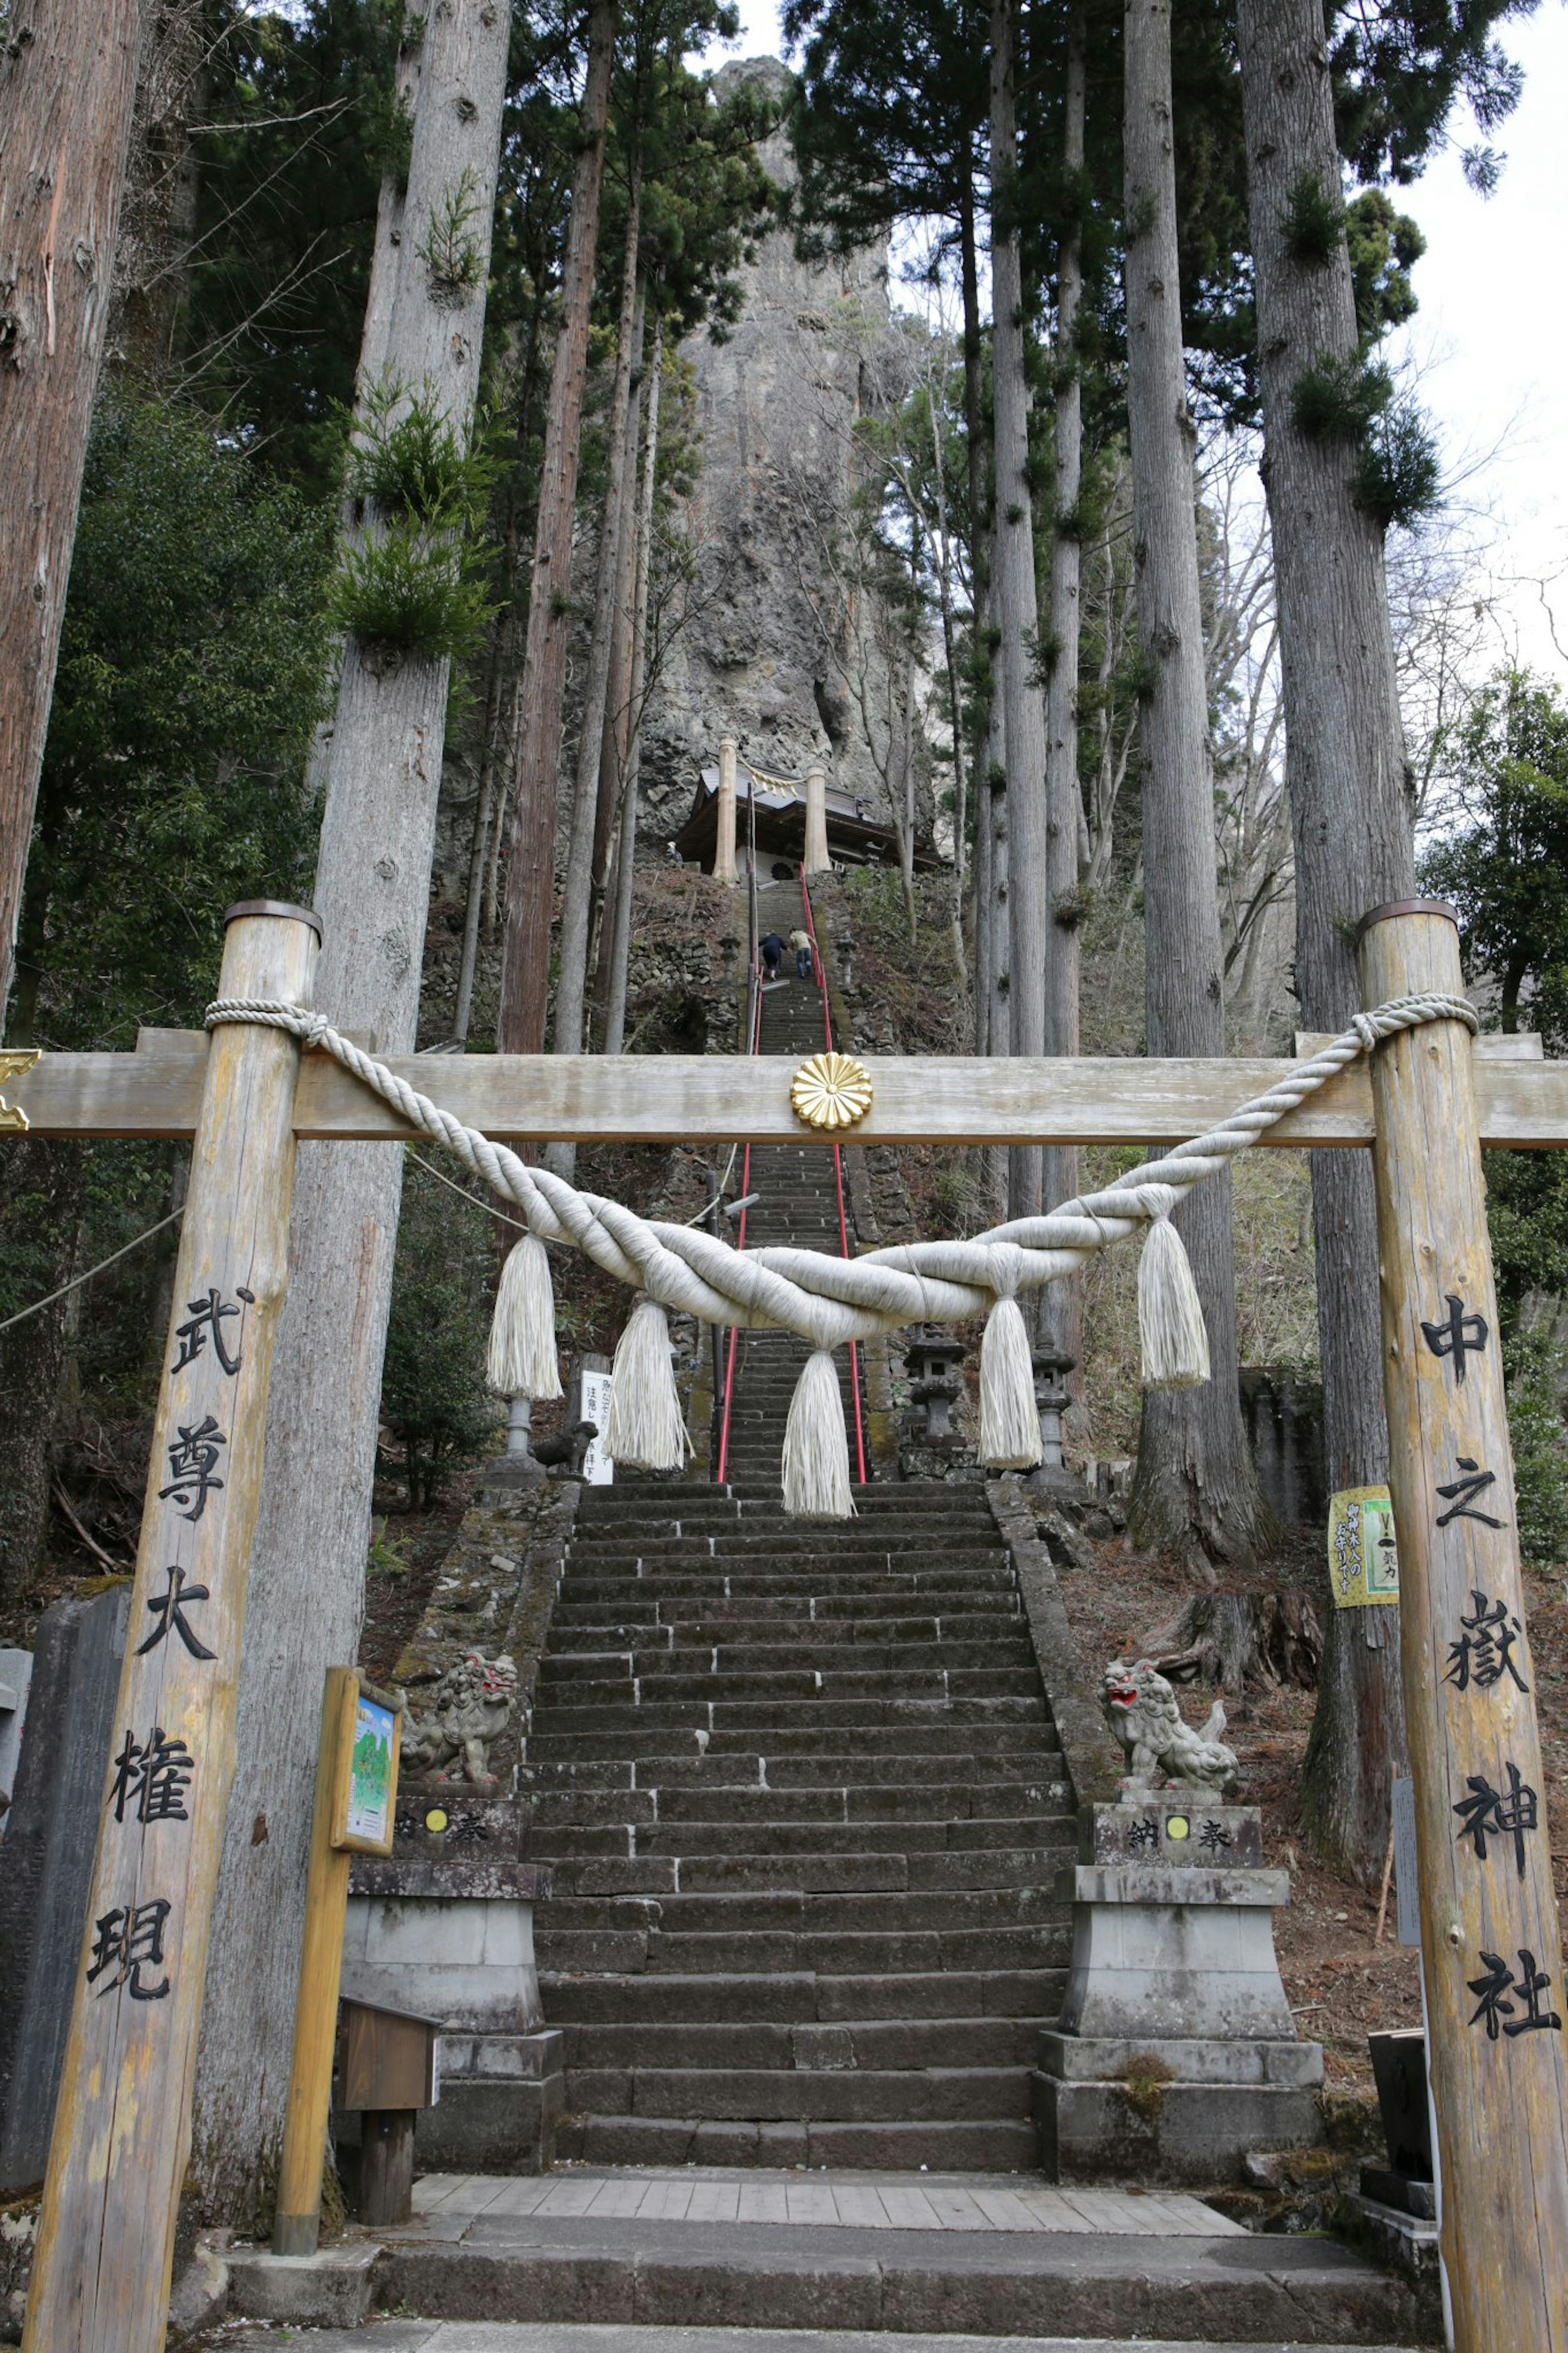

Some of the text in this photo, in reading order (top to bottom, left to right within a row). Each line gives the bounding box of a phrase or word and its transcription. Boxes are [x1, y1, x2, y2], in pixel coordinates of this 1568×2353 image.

[1336, 1523, 1350, 1594] お守りです
[1347, 1503, 1361, 1576] 御神木入の
[87, 1287, 255, 2001] 武尊大権現
[1421, 1295, 1561, 2041] 中之嶽神社
[1127, 1819, 1231, 1853] 奉 納
